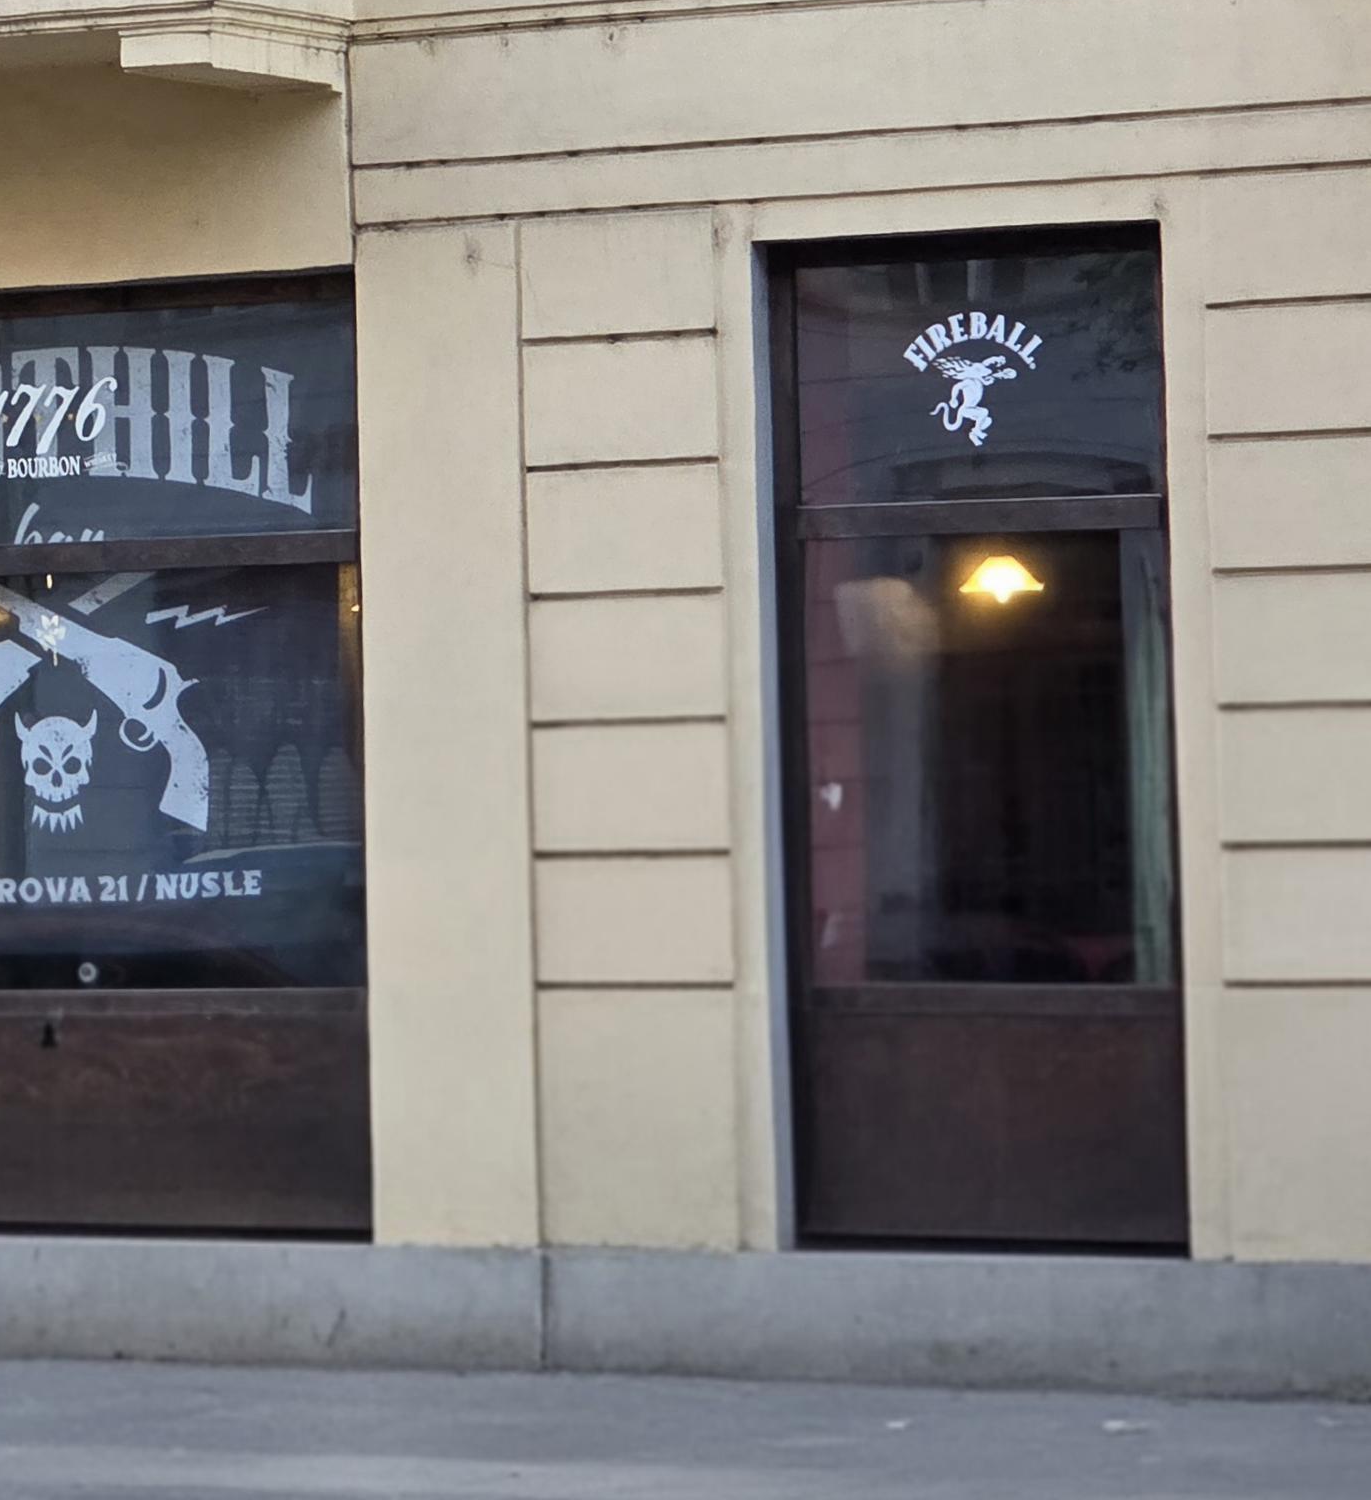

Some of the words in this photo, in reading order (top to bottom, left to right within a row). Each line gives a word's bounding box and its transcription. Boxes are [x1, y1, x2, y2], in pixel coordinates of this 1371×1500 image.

[903, 311, 1044, 372] FIREBALL
[7, 456, 81, 479] BOURBON
[98, 874, 130, 902] 21
[155, 870, 262, 899] NUSLE
